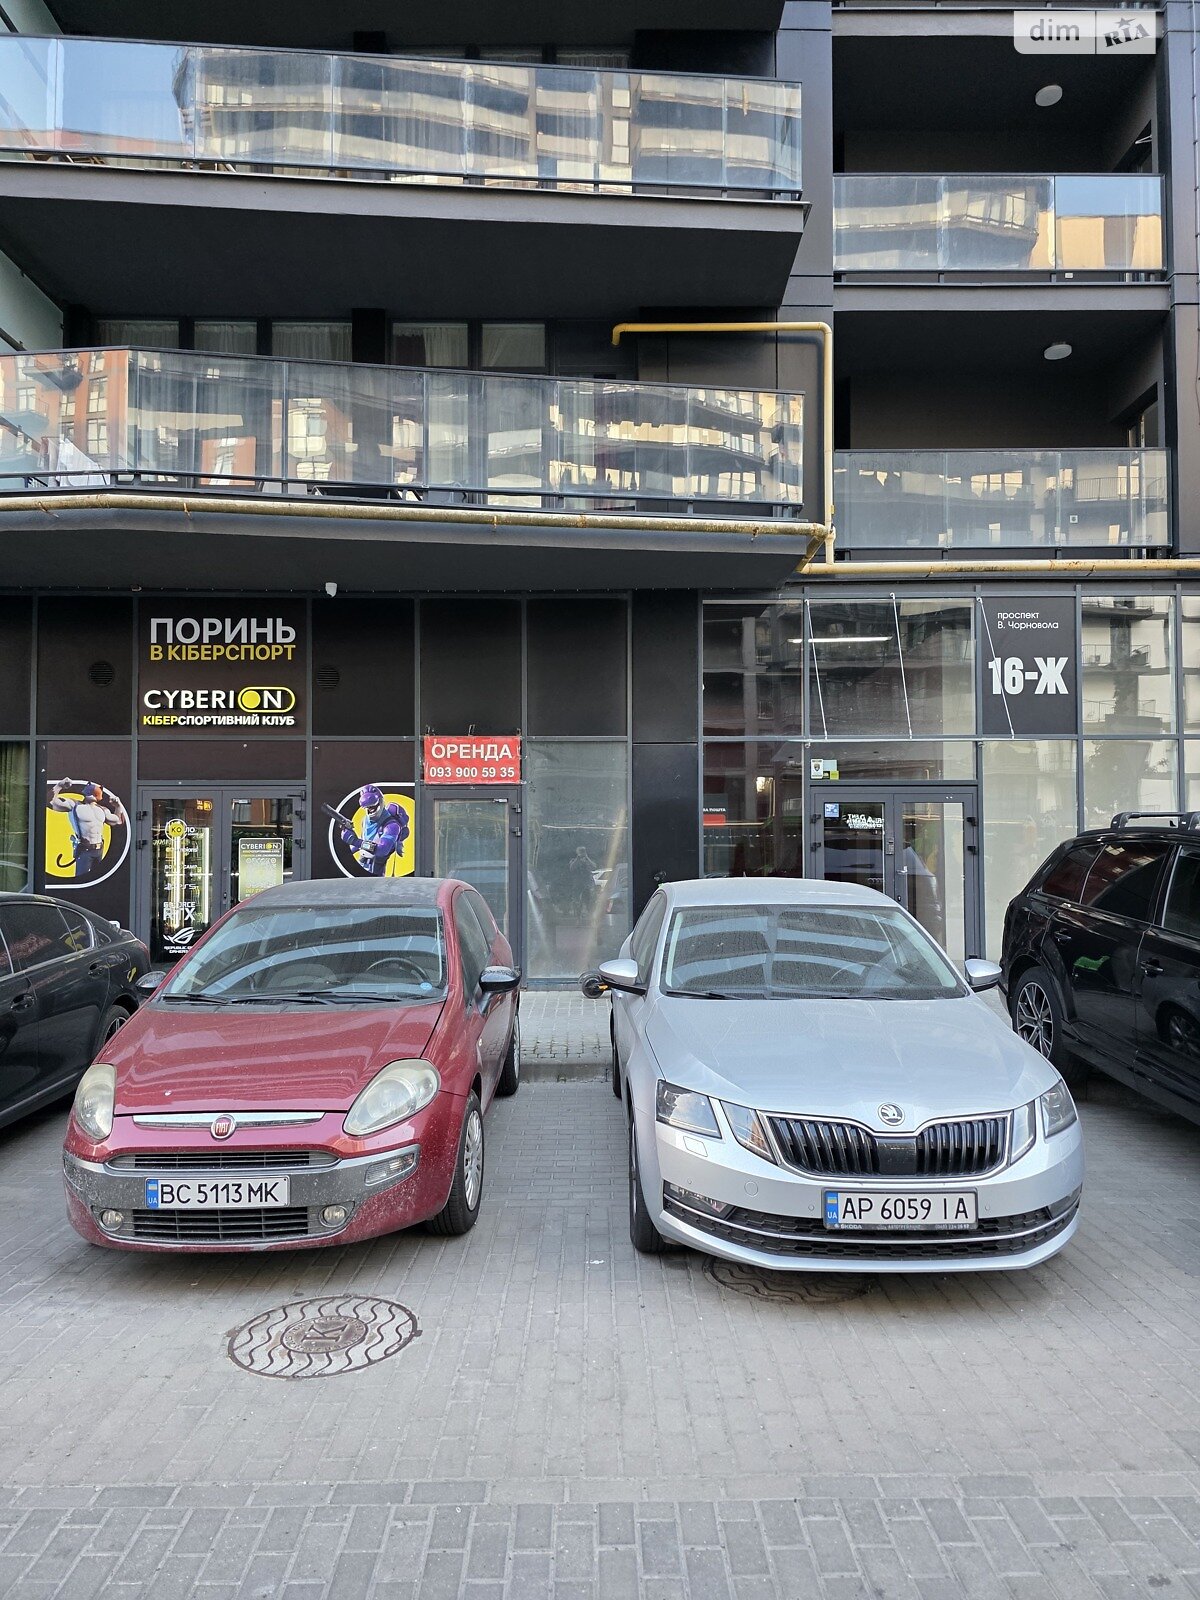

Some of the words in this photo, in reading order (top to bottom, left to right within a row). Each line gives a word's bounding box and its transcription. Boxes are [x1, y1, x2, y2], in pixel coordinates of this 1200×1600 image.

[997, 612, 1040, 620] проспект
[150, 618, 296, 643] ПОРИНЬ
[997, 621, 1006, 629] В.
[1008, 621, 1059, 630] Чорновола
[150, 645, 163, 661] В
[168, 645, 296, 661] КІБЕРСПОРТ
[988, 657, 1069, 695] 16-Ж
[143, 688, 288, 711] CYBERION
[143, 714, 259, 726] КІБЕРСПОРТИВНИЙ
[262, 716, 295, 726] КЛУБ
[431, 744, 512, 761] ОРЕНДА
[430, 767, 452, 777] 093
[455, 767, 478, 777] 900
[481, 767, 496, 777] 59
[500, 767, 515, 777] 35
[215, 1122, 230, 1133] FIAT
[160, 1183, 191, 1204] BC
[197, 1183, 243, 1204] 5113
[248, 1182, 279, 1203] MK
[827, 1211, 838, 1219] UA
[842, 1197, 873, 1219] AP
[881, 1197, 932, 1220] 6059
[943, 1197, 969, 1219] IA
